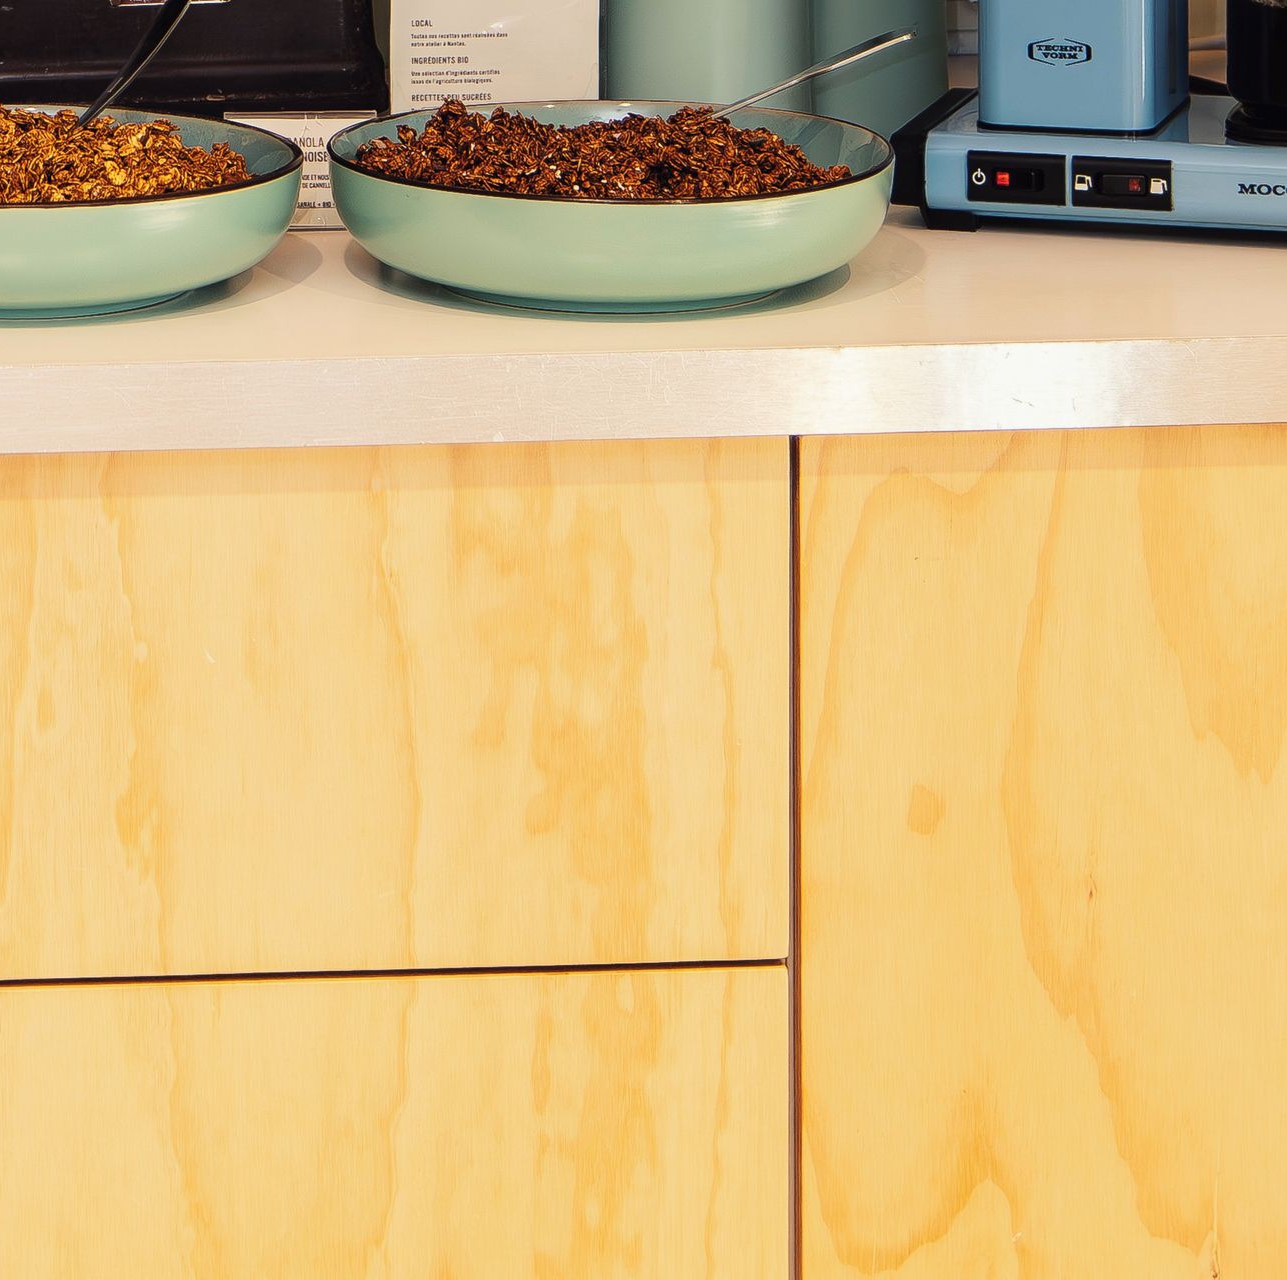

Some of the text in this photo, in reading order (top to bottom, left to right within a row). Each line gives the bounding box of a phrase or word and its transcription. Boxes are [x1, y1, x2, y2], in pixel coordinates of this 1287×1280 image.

[1036, 44, 1084, 52] TECHNI
[411, 56, 469, 64] INGRÉDIENTS BIO
[411, 93, 444, 101] RECETTES
[462, 92, 491, 101] SUCRÉES
[293, 136, 324, 147] ANOLA
[1238, 183, 1287, 196] MOC
